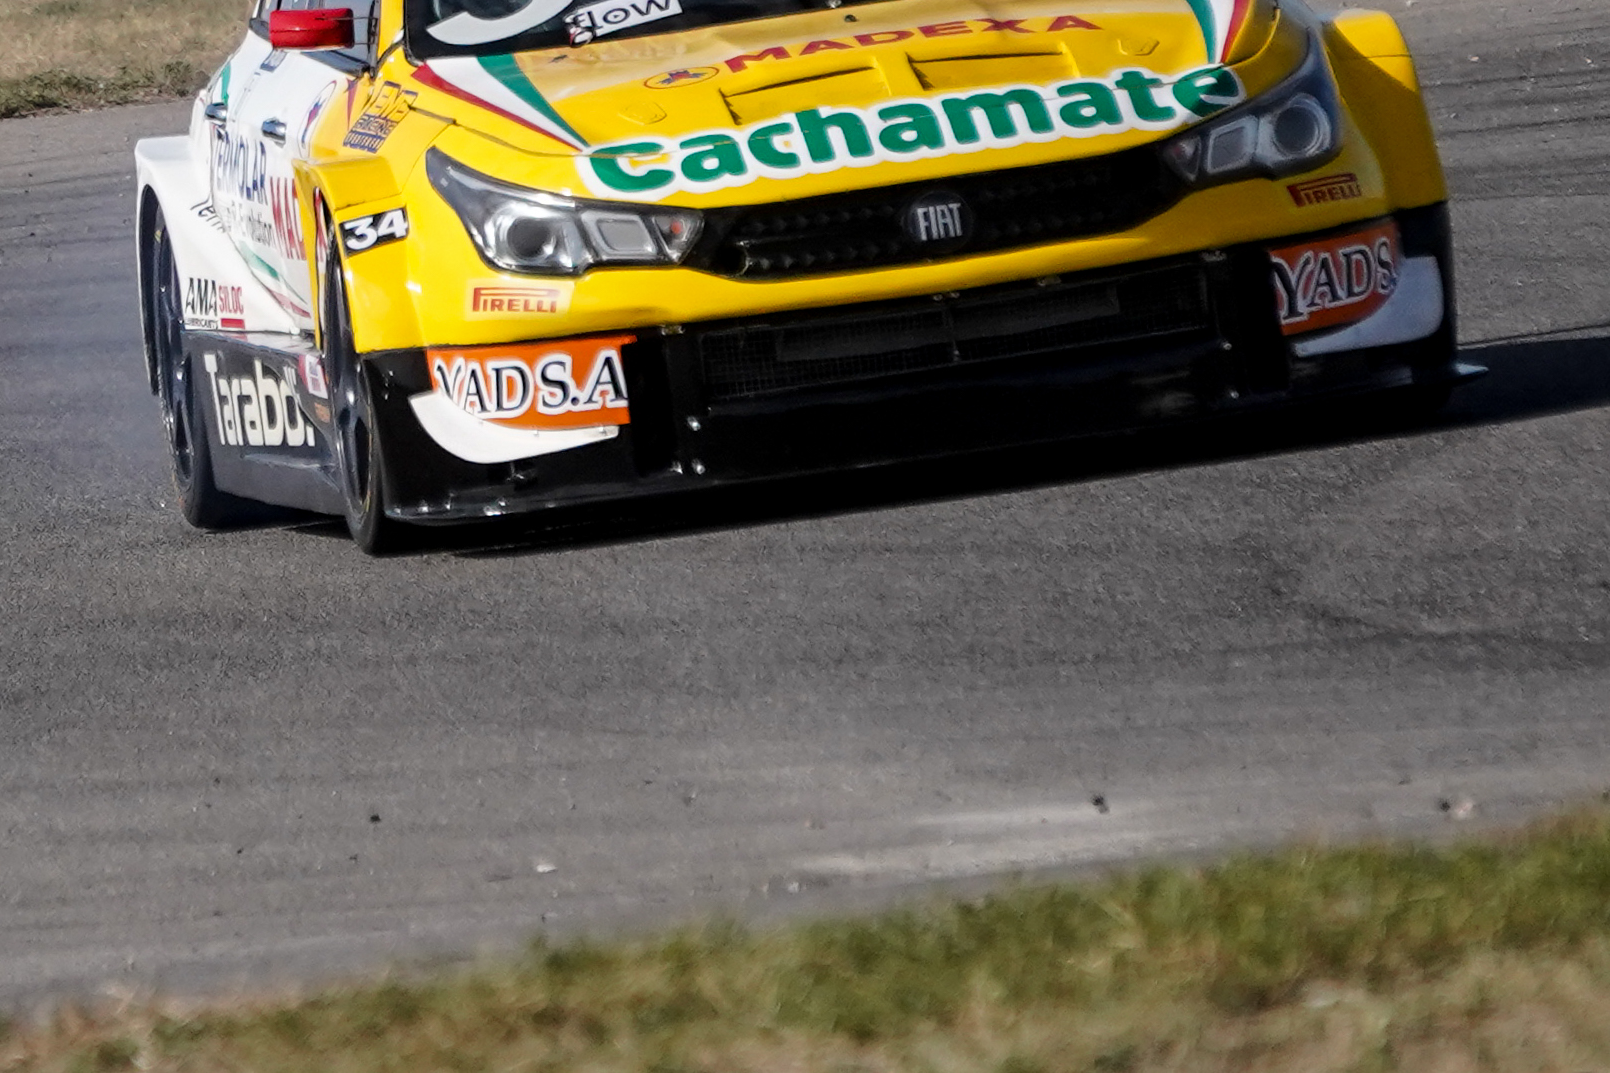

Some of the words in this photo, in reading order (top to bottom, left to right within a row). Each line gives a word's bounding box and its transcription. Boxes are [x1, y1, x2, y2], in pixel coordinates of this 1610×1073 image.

[724, 13, 1106, 73] MADEXA
[589, 62, 1241, 193] Cachamate
[1286, 172, 1363, 208] PIRELLI
[343, 208, 409, 251] 34
[915, 201, 964, 242] FIAT
[472, 286, 561, 314] PIRELLI
[203, 353, 316, 447] Tarabo
